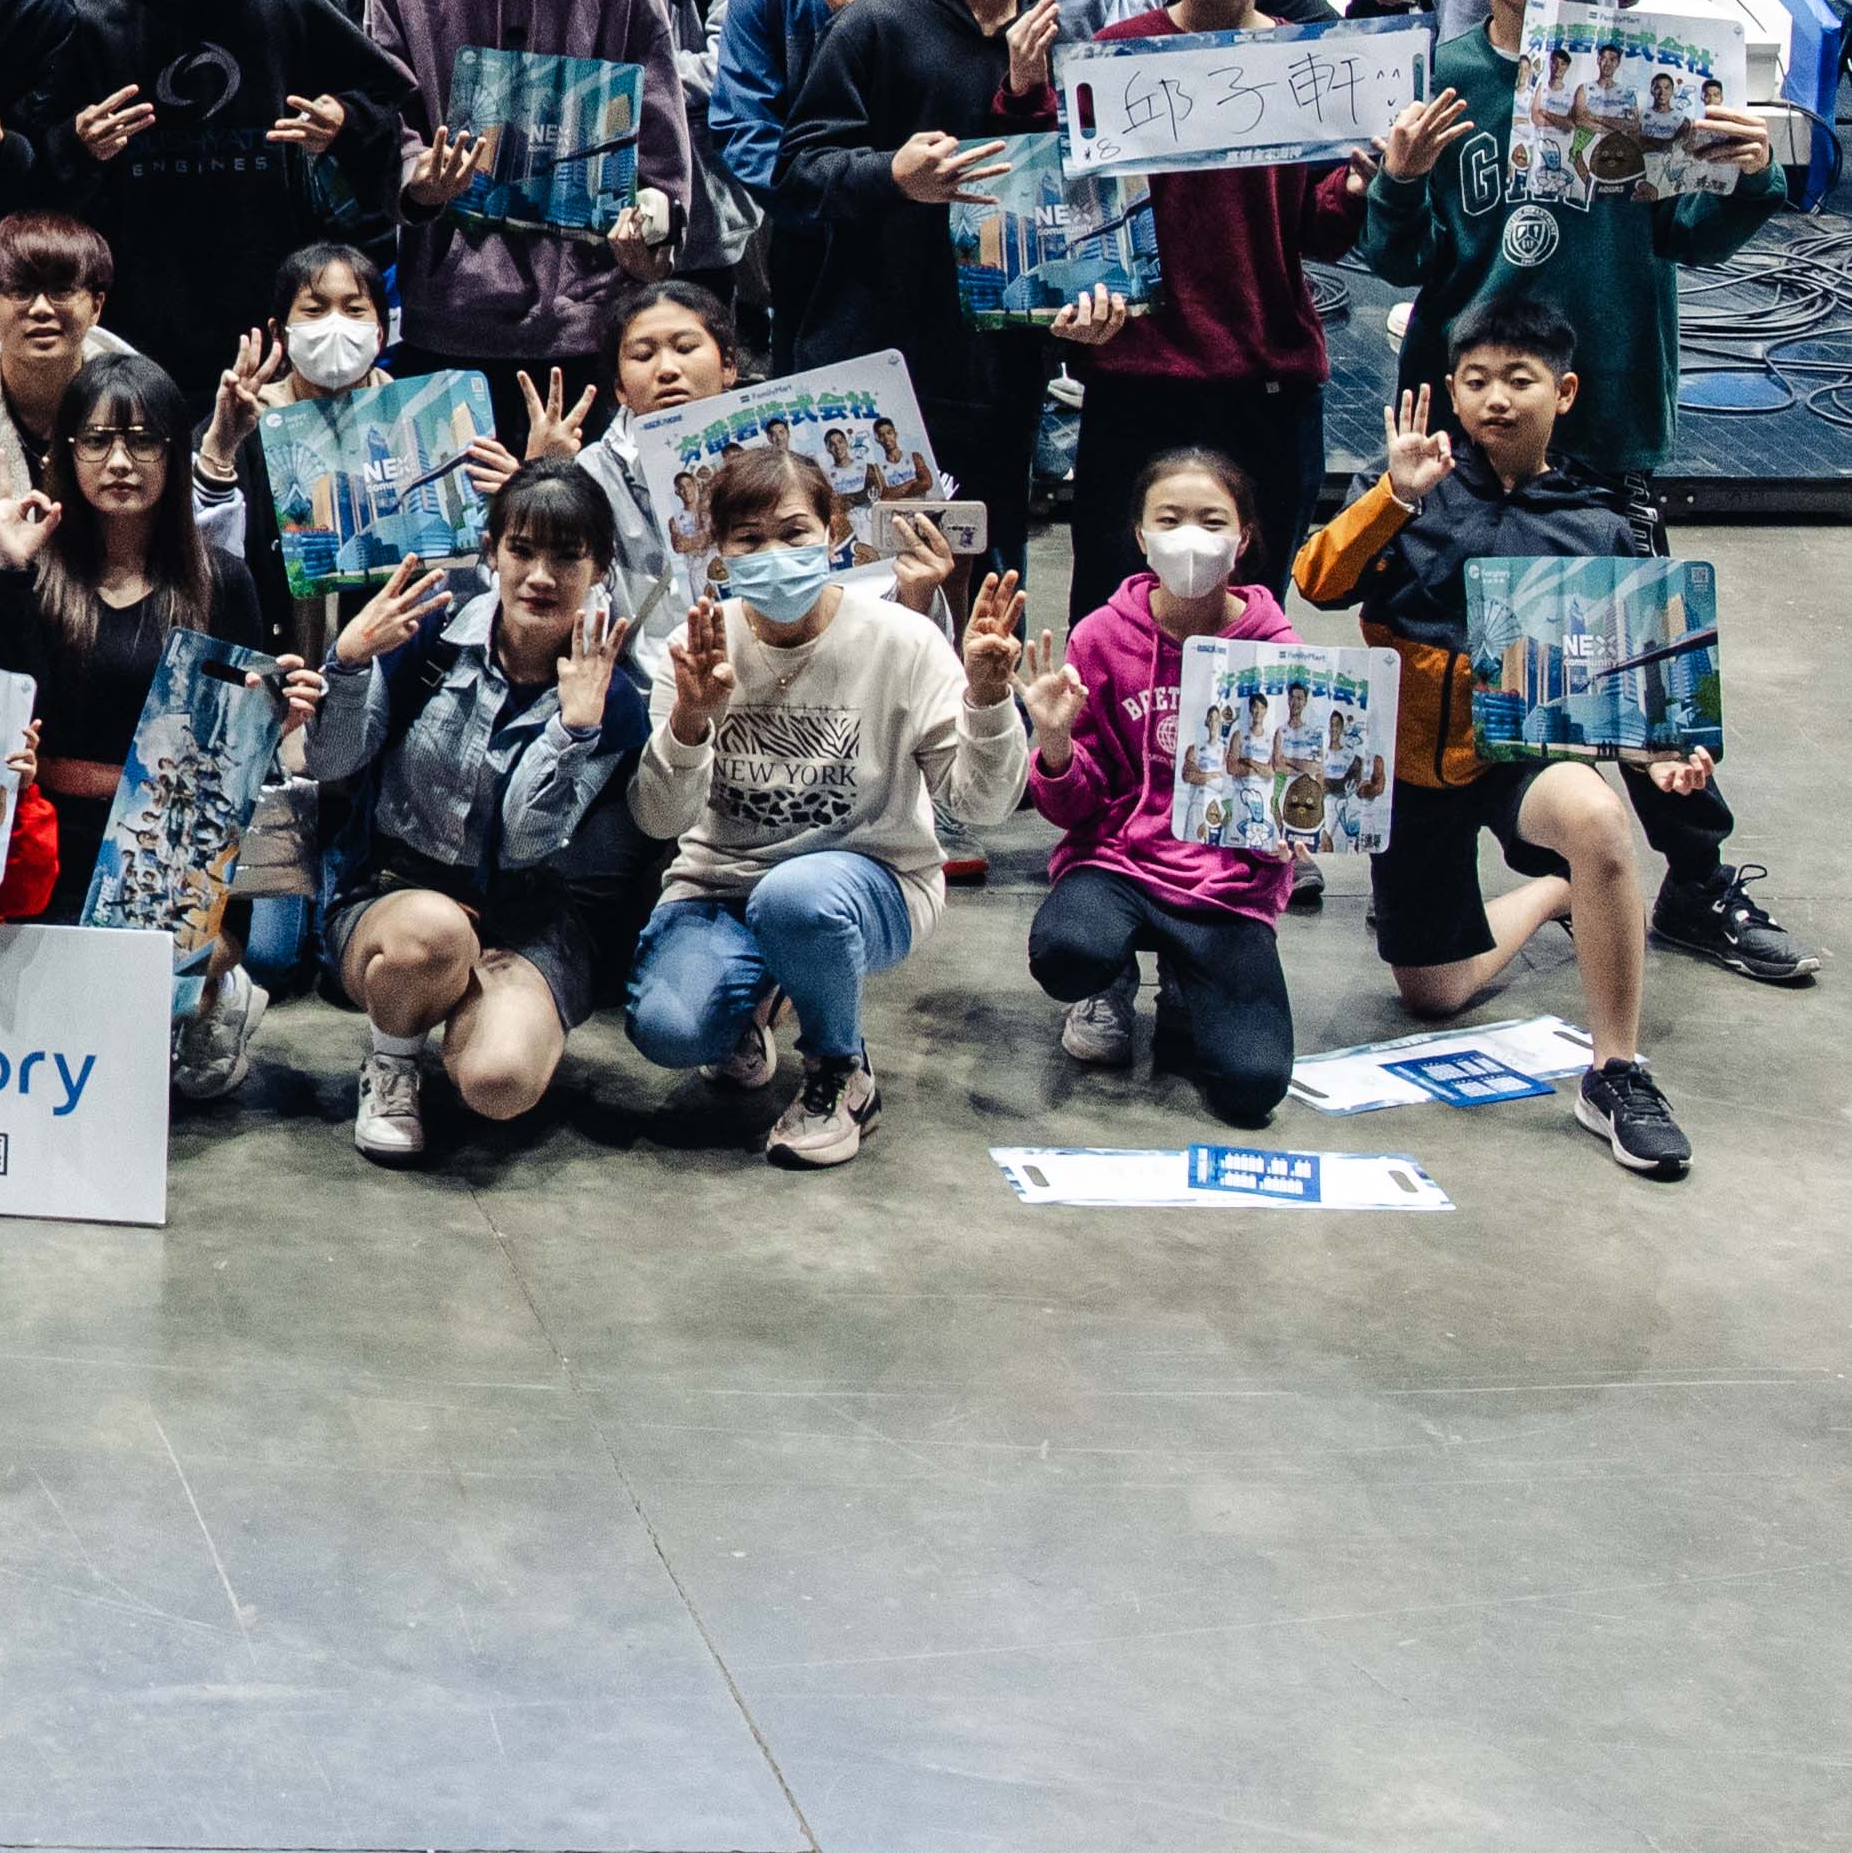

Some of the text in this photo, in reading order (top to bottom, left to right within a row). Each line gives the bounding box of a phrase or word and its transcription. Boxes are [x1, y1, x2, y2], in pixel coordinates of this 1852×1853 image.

[132, 157, 269, 177] ENGINES
[1034, 202, 1092, 225] NEX
[363, 455, 410, 483] NEX
[1562, 634, 1617, 656] NEX
[712, 758, 858, 789] NEW YORK
